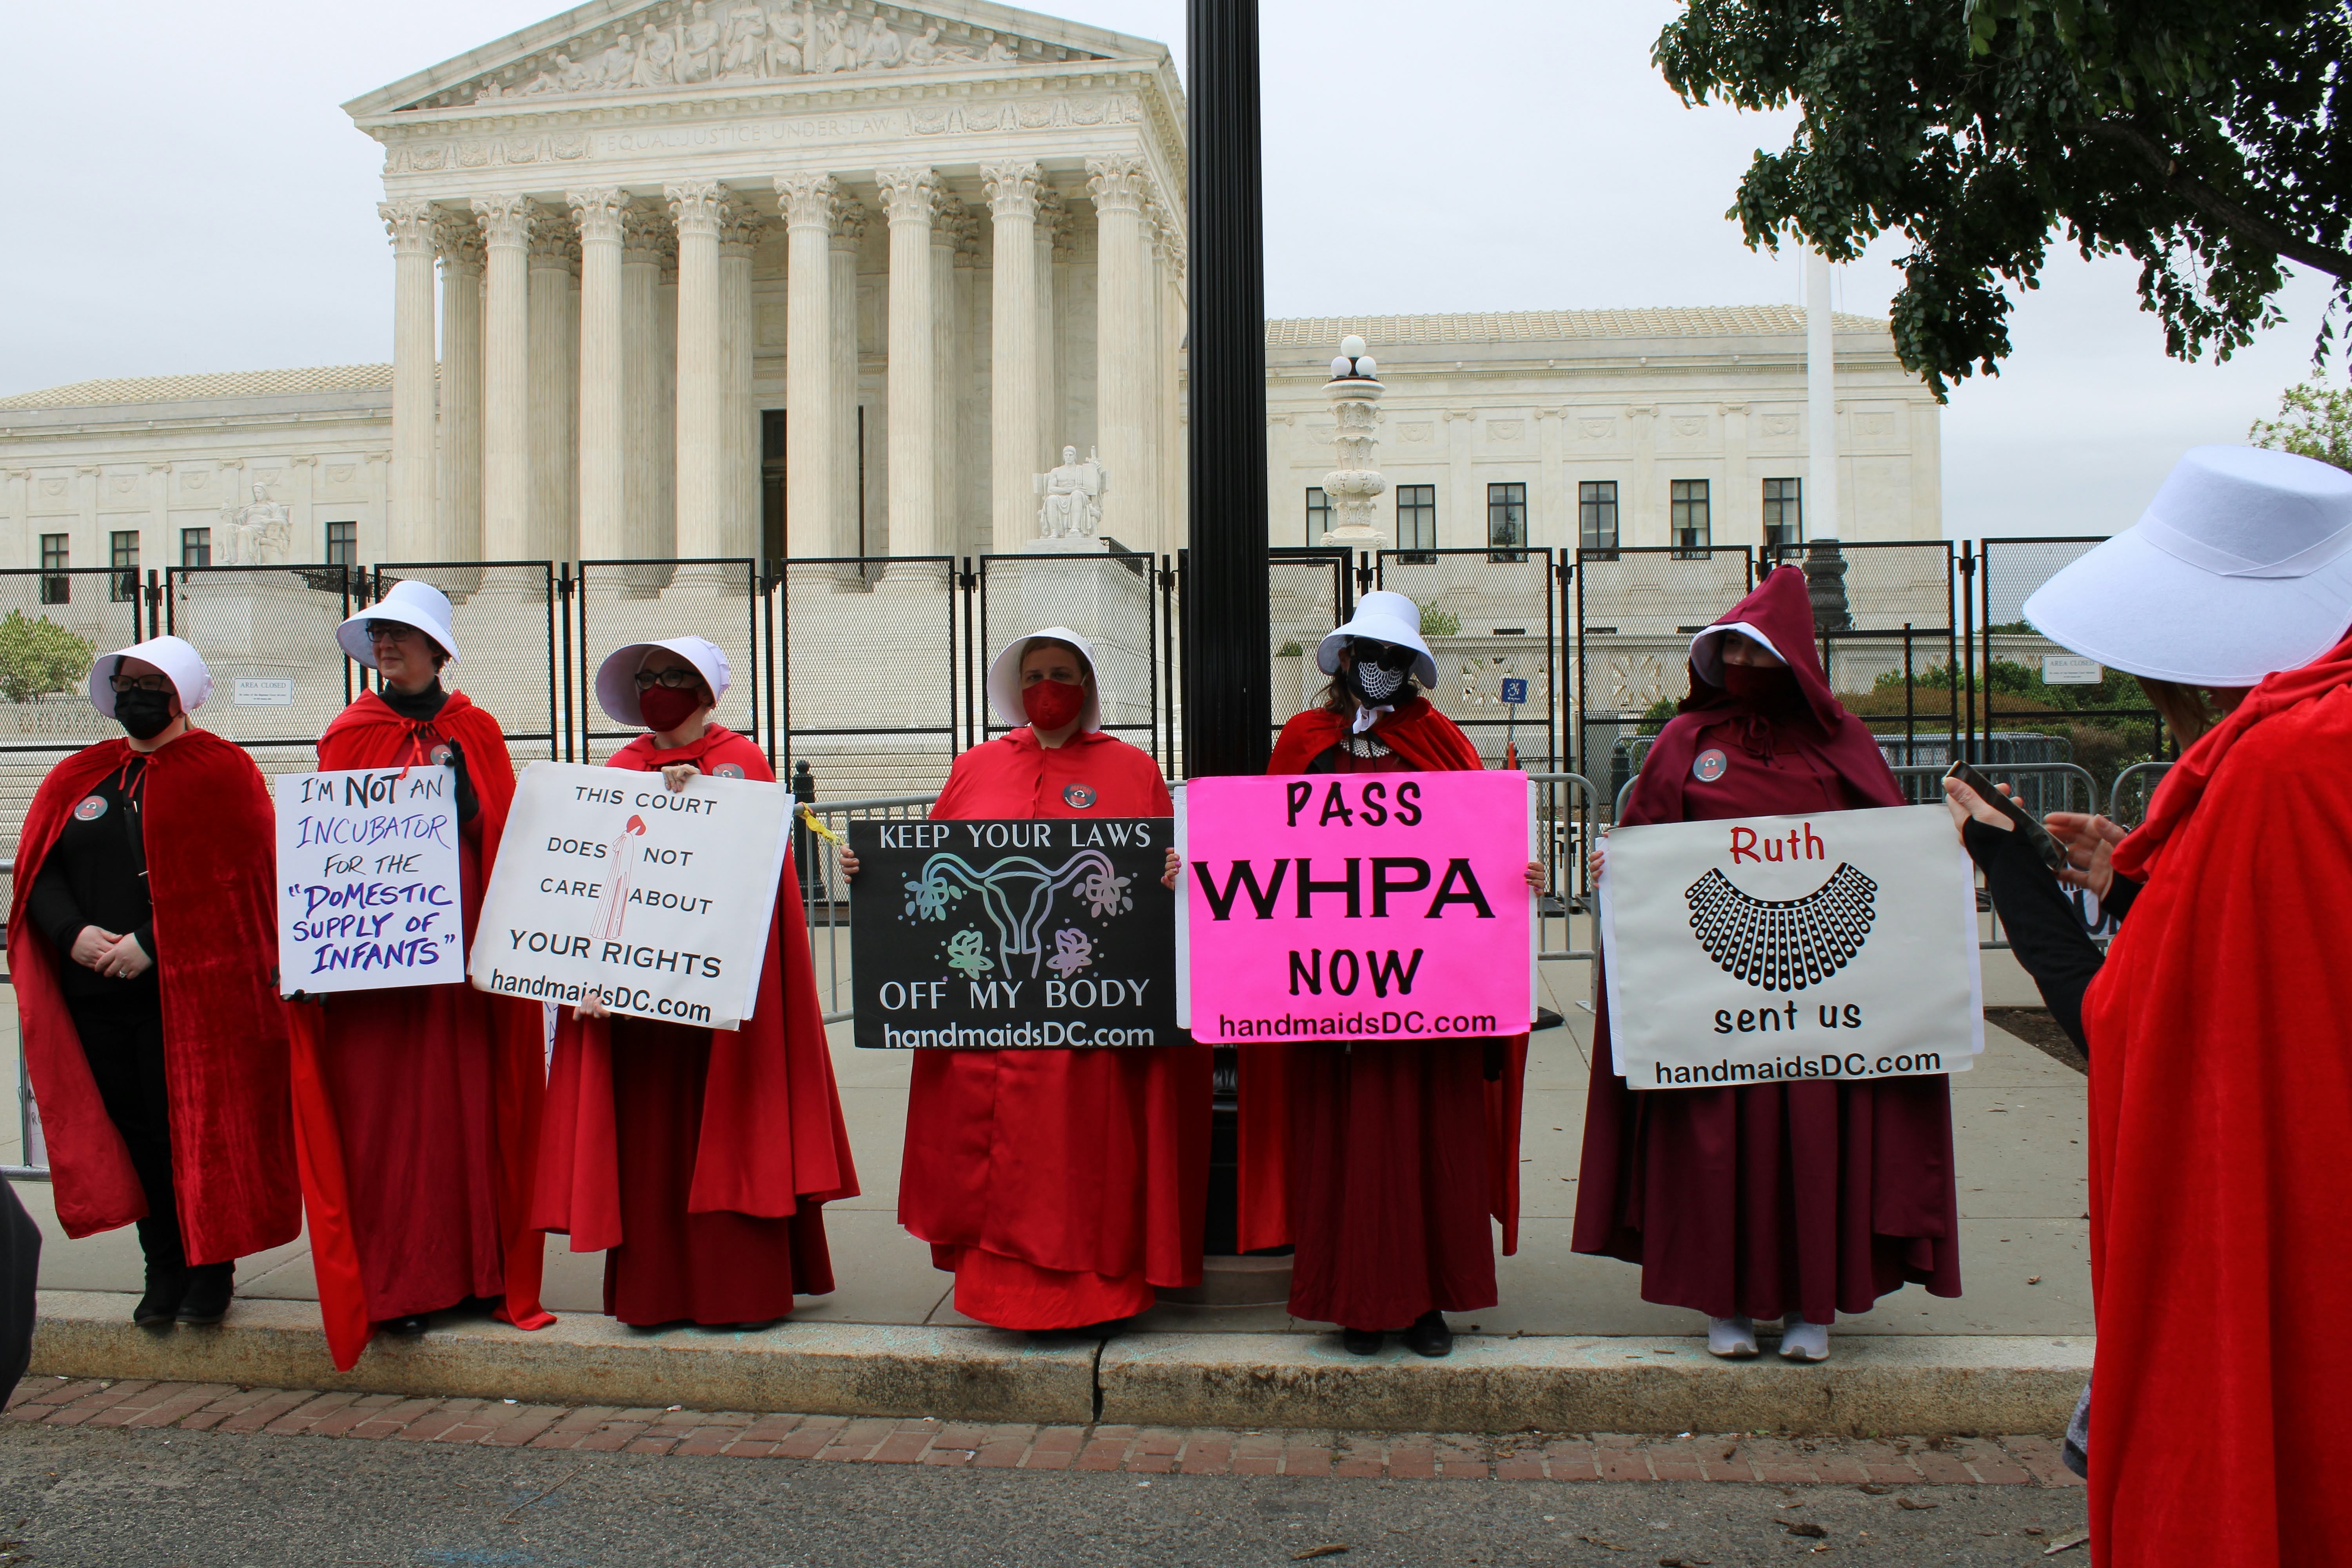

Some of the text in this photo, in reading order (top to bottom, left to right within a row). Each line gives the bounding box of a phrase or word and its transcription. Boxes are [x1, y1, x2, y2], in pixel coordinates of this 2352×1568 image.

[608, 117, 890, 151] EQUAL JUSTICE UNDER LAW
[301, 773, 443, 808] I'M NOT AN
[575, 786, 718, 815] THIS COURT
[1287, 781, 1423, 827] PASS
[296, 814, 451, 849] INCUBATOR
[880, 823, 1151, 848] KEEP YOUR LAWS
[1730, 822, 1825, 864] Ruth
[324, 853, 423, 877] FOR THE
[546, 837, 693, 866] DOES NOT
[541, 878, 713, 915] CARE ABOUT
[1191, 857, 1496, 921] WHPA
[293, 912, 440, 941] SUPPLY OF
[510, 929, 722, 978] YOUR RIGHTS
[1289, 948, 1424, 998] NOW
[879, 978, 1150, 1010] OFF MY BODY
[1220, 1011, 1496, 1037] handmaidsDC.com
[1714, 1000, 1862, 1034] sent us
[884, 1021, 1154, 1048] handmaidsDC.com
[1655, 1052, 1941, 1083] handmaidsDC.com
